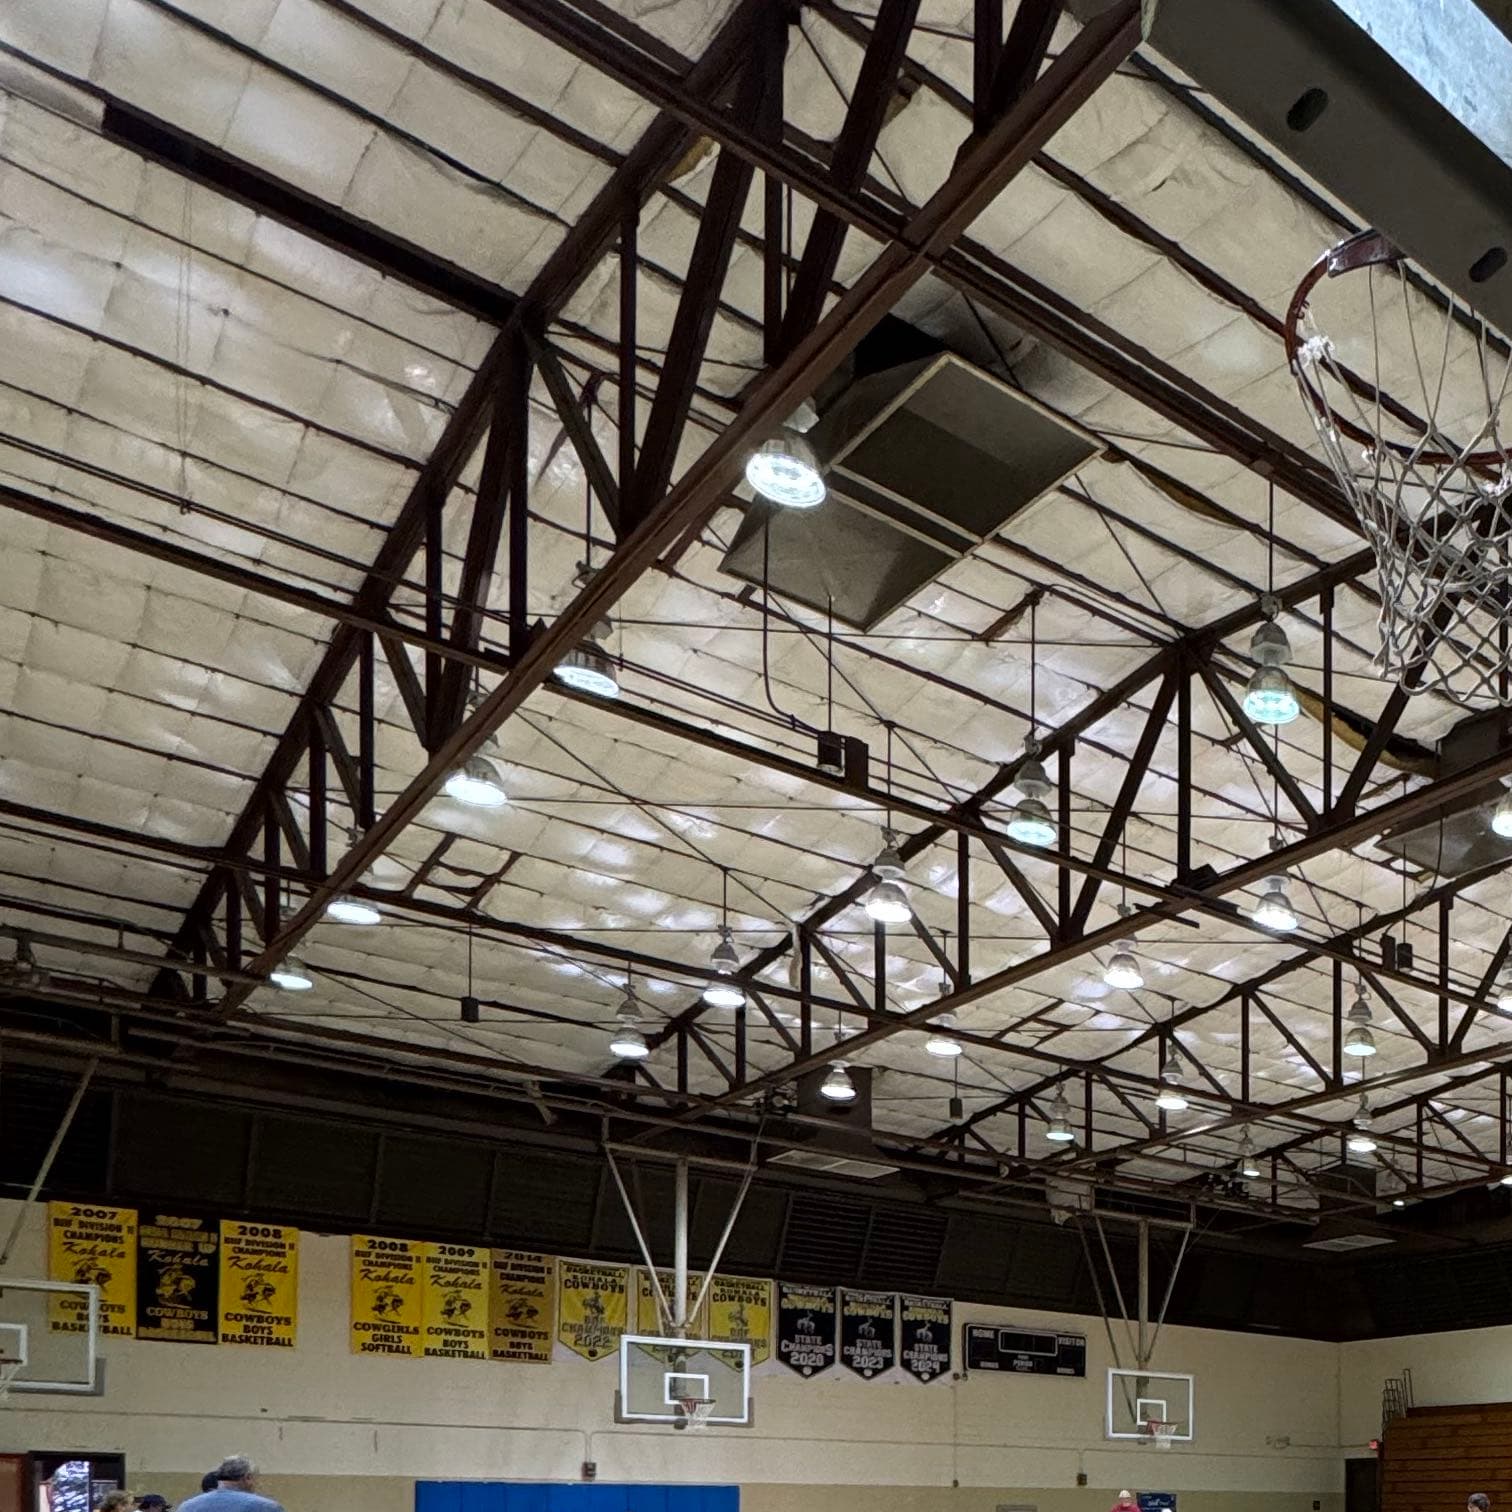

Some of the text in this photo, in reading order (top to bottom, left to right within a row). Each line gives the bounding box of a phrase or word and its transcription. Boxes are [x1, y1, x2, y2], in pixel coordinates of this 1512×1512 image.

[70, 1206, 118, 1220] 2007
[238, 1225, 282, 1239] 2008
[62, 1242, 125, 1258] Kohala
[367, 1239, 408, 1252] 2008
[438, 1245, 475, 1257] 2009
[148, 1250, 208, 1266] Kohala
[227, 1256, 288, 1273] Kohala
[360, 1269, 415, 1285] Kohala
[430, 1274, 482, 1289] Kohala
[564, 1279, 624, 1294] COWBOYS
[60, 1300, 125, 1313] COWOYS
[713, 1293, 767, 1307] COWBOYS
[146, 1307, 208, 1320] COWBOYS
[224, 1312, 292, 1326] COWBOYS
[243, 1324, 273, 1335] BOYS
[353, 1322, 419, 1335] COWGIRLS
[427, 1326, 484, 1339] COWBOYS
[494, 1327, 548, 1340] COWBOYS
[222, 1333, 293, 1347] BASKETBALL
[372, 1333, 402, 1344] GIRLS
[443, 1339, 469, 1349] BOYS
[795, 1334, 822, 1345] STATE
[856, 1339, 882, 1349] STATE
[361, 1343, 412, 1354] SOFTBALL
[509, 1341, 533, 1350] BOYS
[781, 1339, 833, 1356] CHAMPIONS
[914, 1343, 938, 1353] STATE
[424, 1347, 485, 1360] BASKETBALL
[493, 1349, 548, 1360] BASKETBALL
[790, 1351, 824, 1366] 2020
[852, 1356, 884, 1369] 2023
